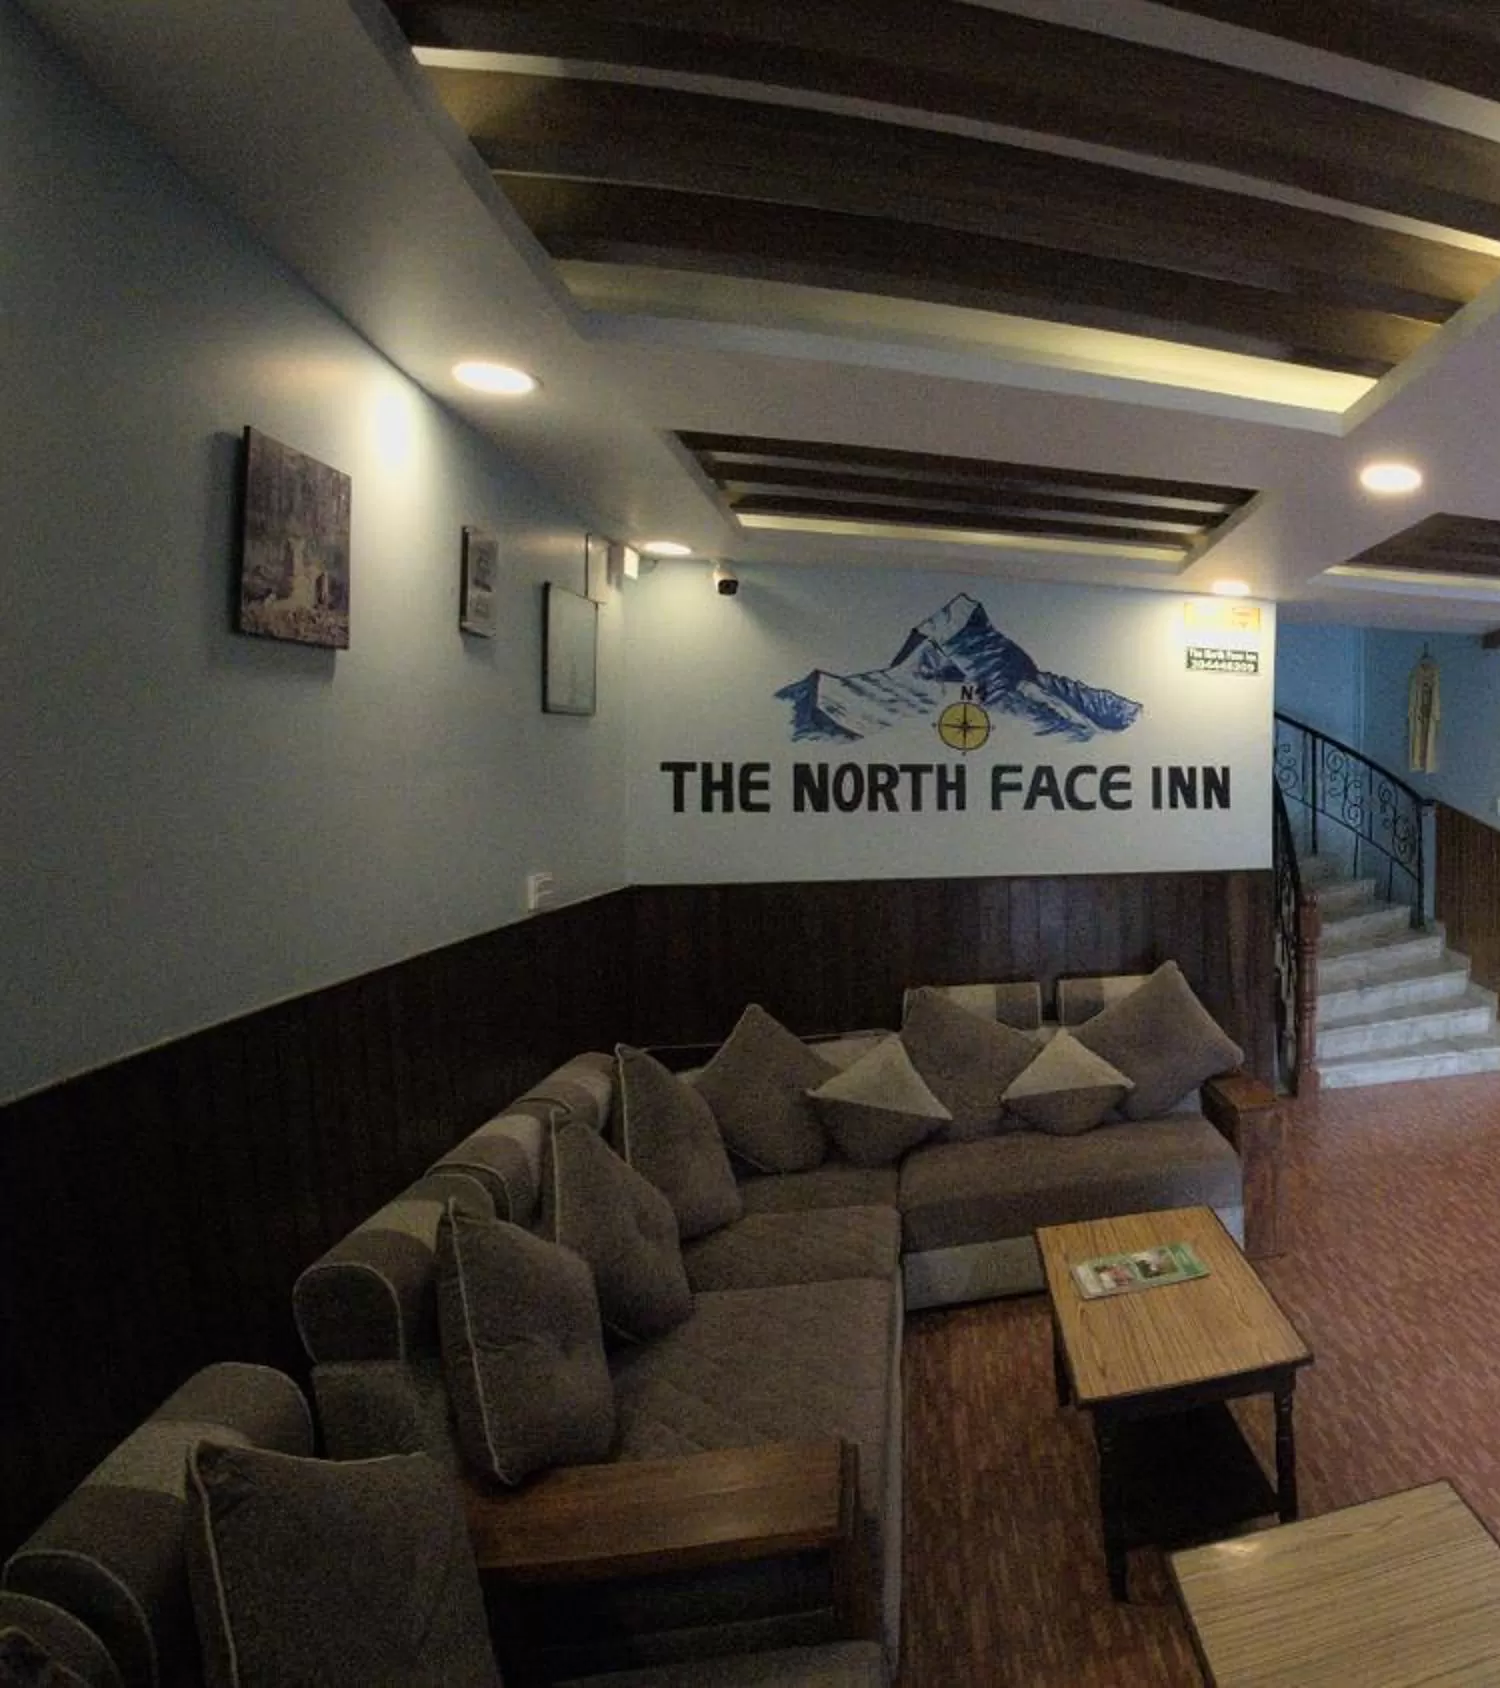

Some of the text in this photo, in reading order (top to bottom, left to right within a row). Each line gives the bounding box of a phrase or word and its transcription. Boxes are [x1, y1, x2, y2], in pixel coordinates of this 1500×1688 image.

[660, 762, 1230, 813] THE NORTH FACE INN
